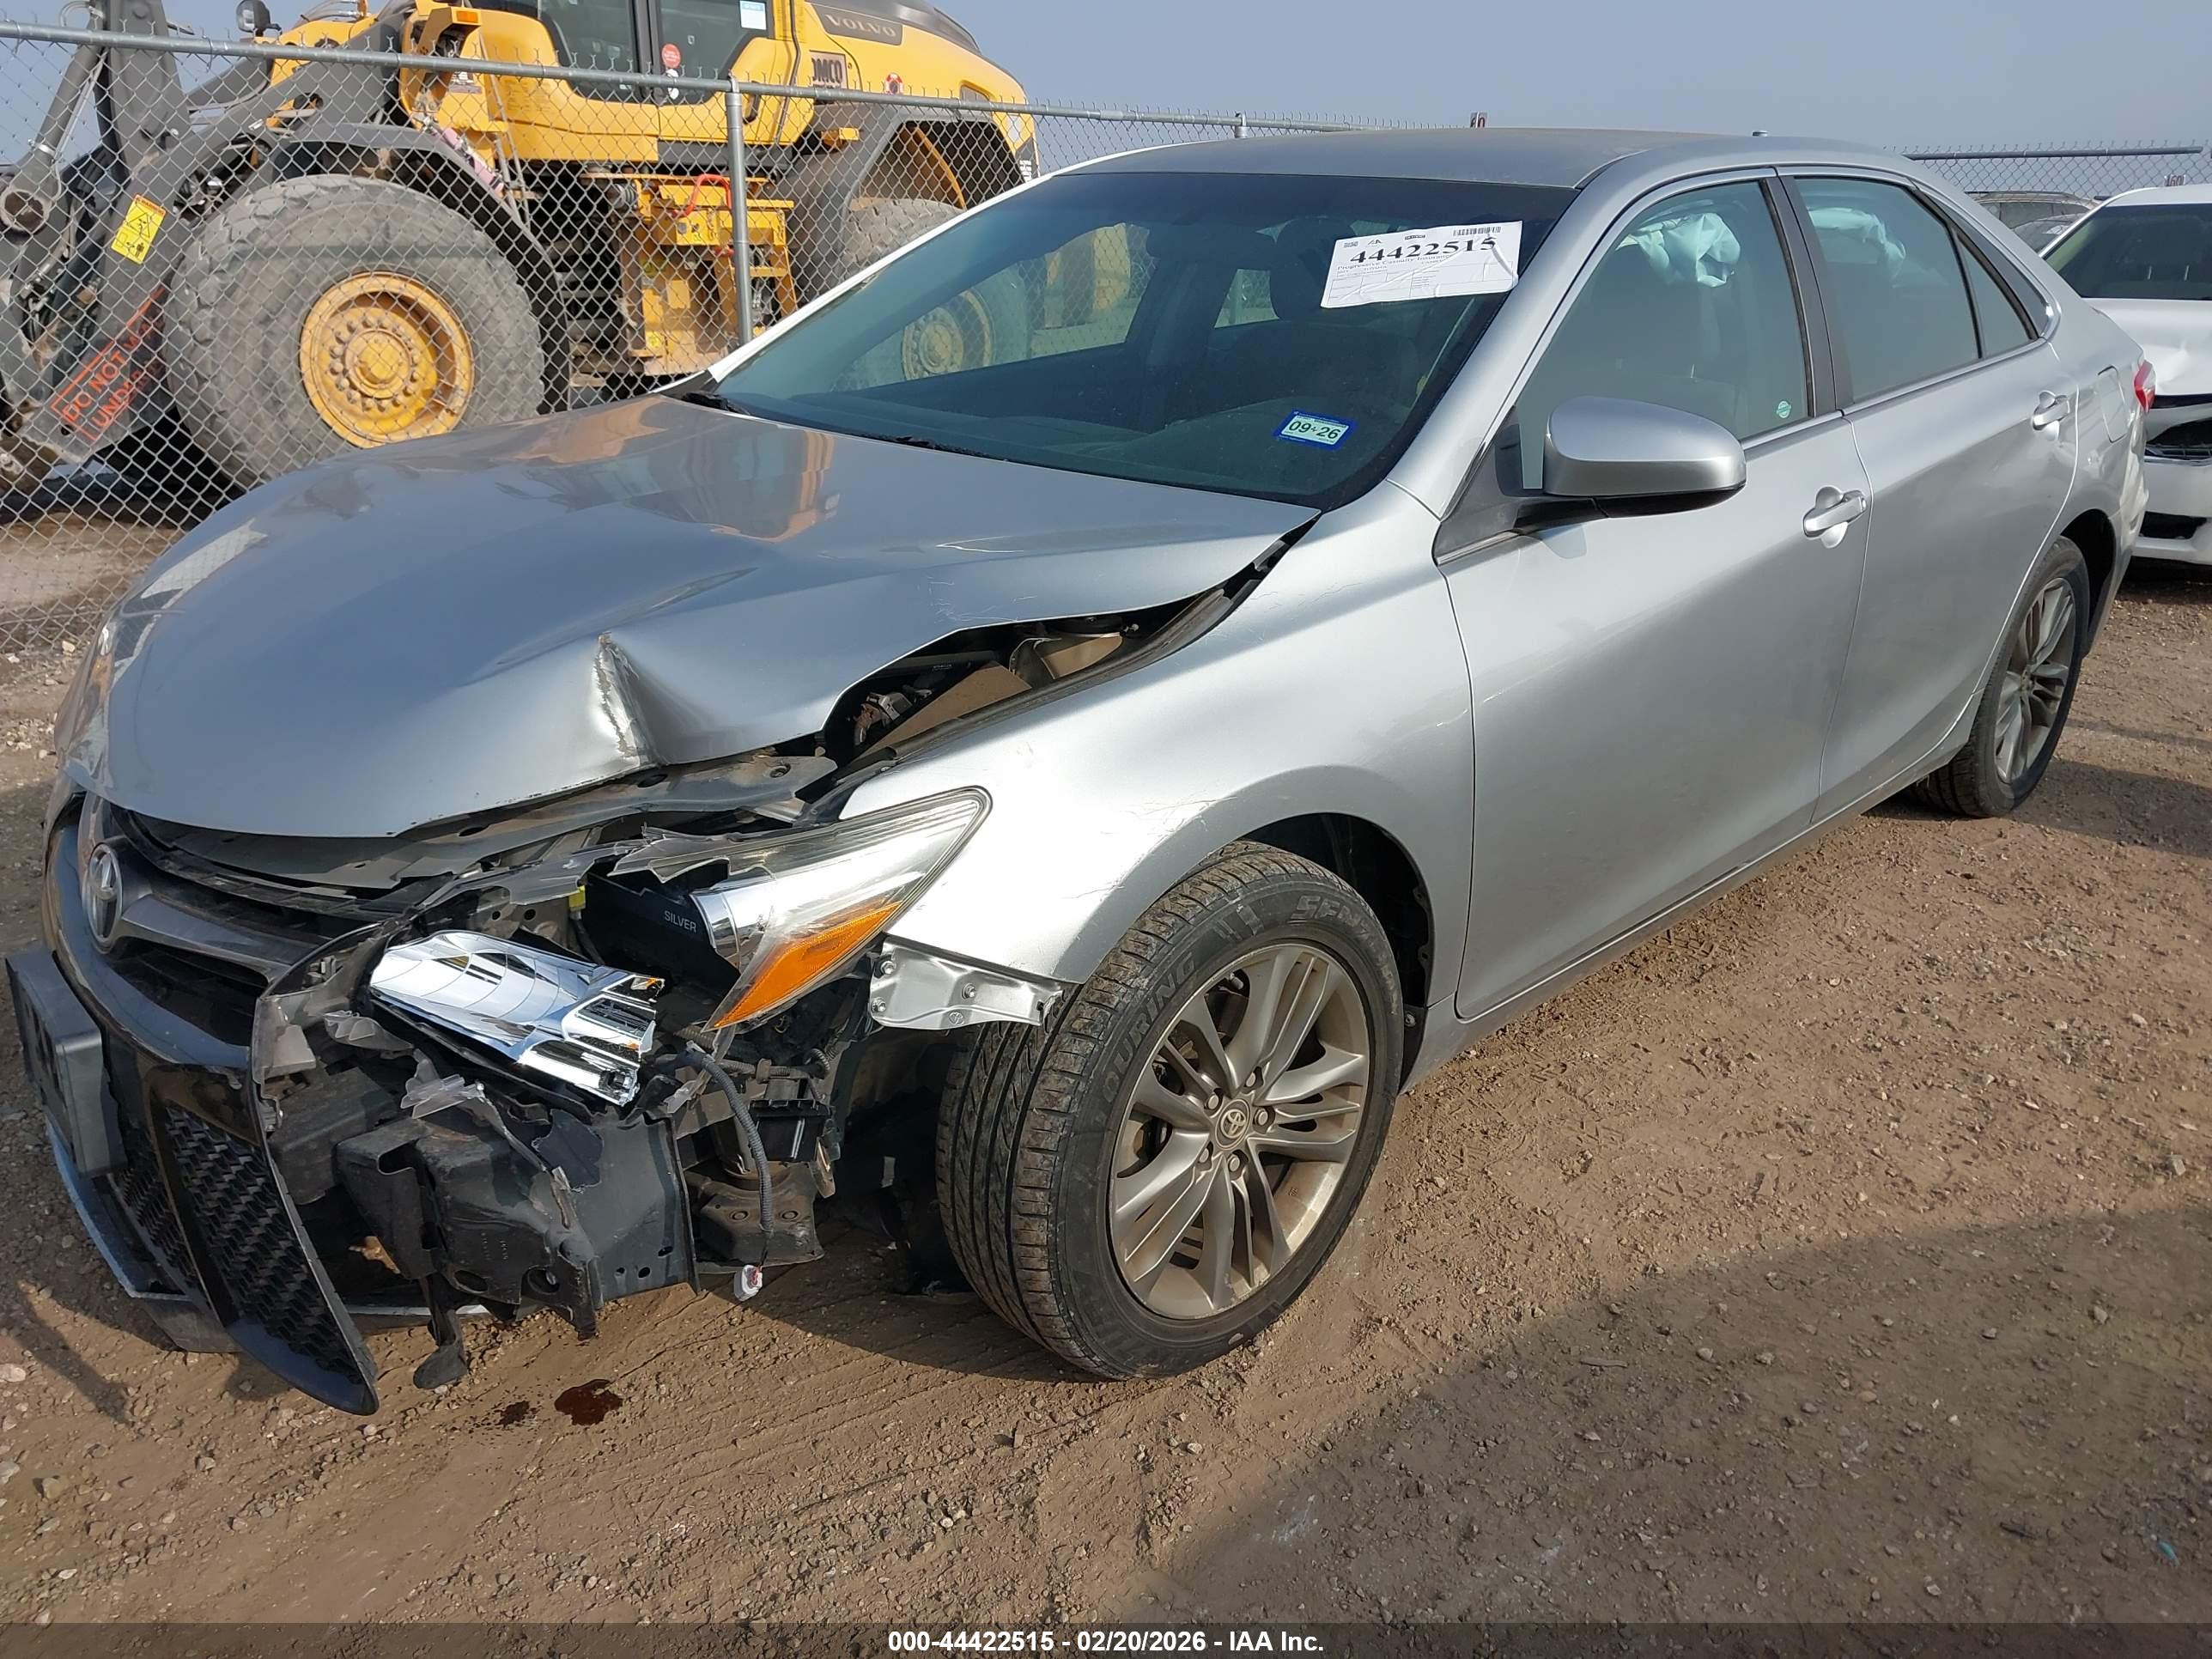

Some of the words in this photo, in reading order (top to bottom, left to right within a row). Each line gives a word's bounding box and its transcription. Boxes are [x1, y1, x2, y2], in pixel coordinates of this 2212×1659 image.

[825, 14, 896, 37] VOLVO
[1350, 236, 1498, 264] 44422515
[63, 391, 92, 421] DO
[89, 350, 127, 392] NOT
[664, 910, 696, 933] SILVER
